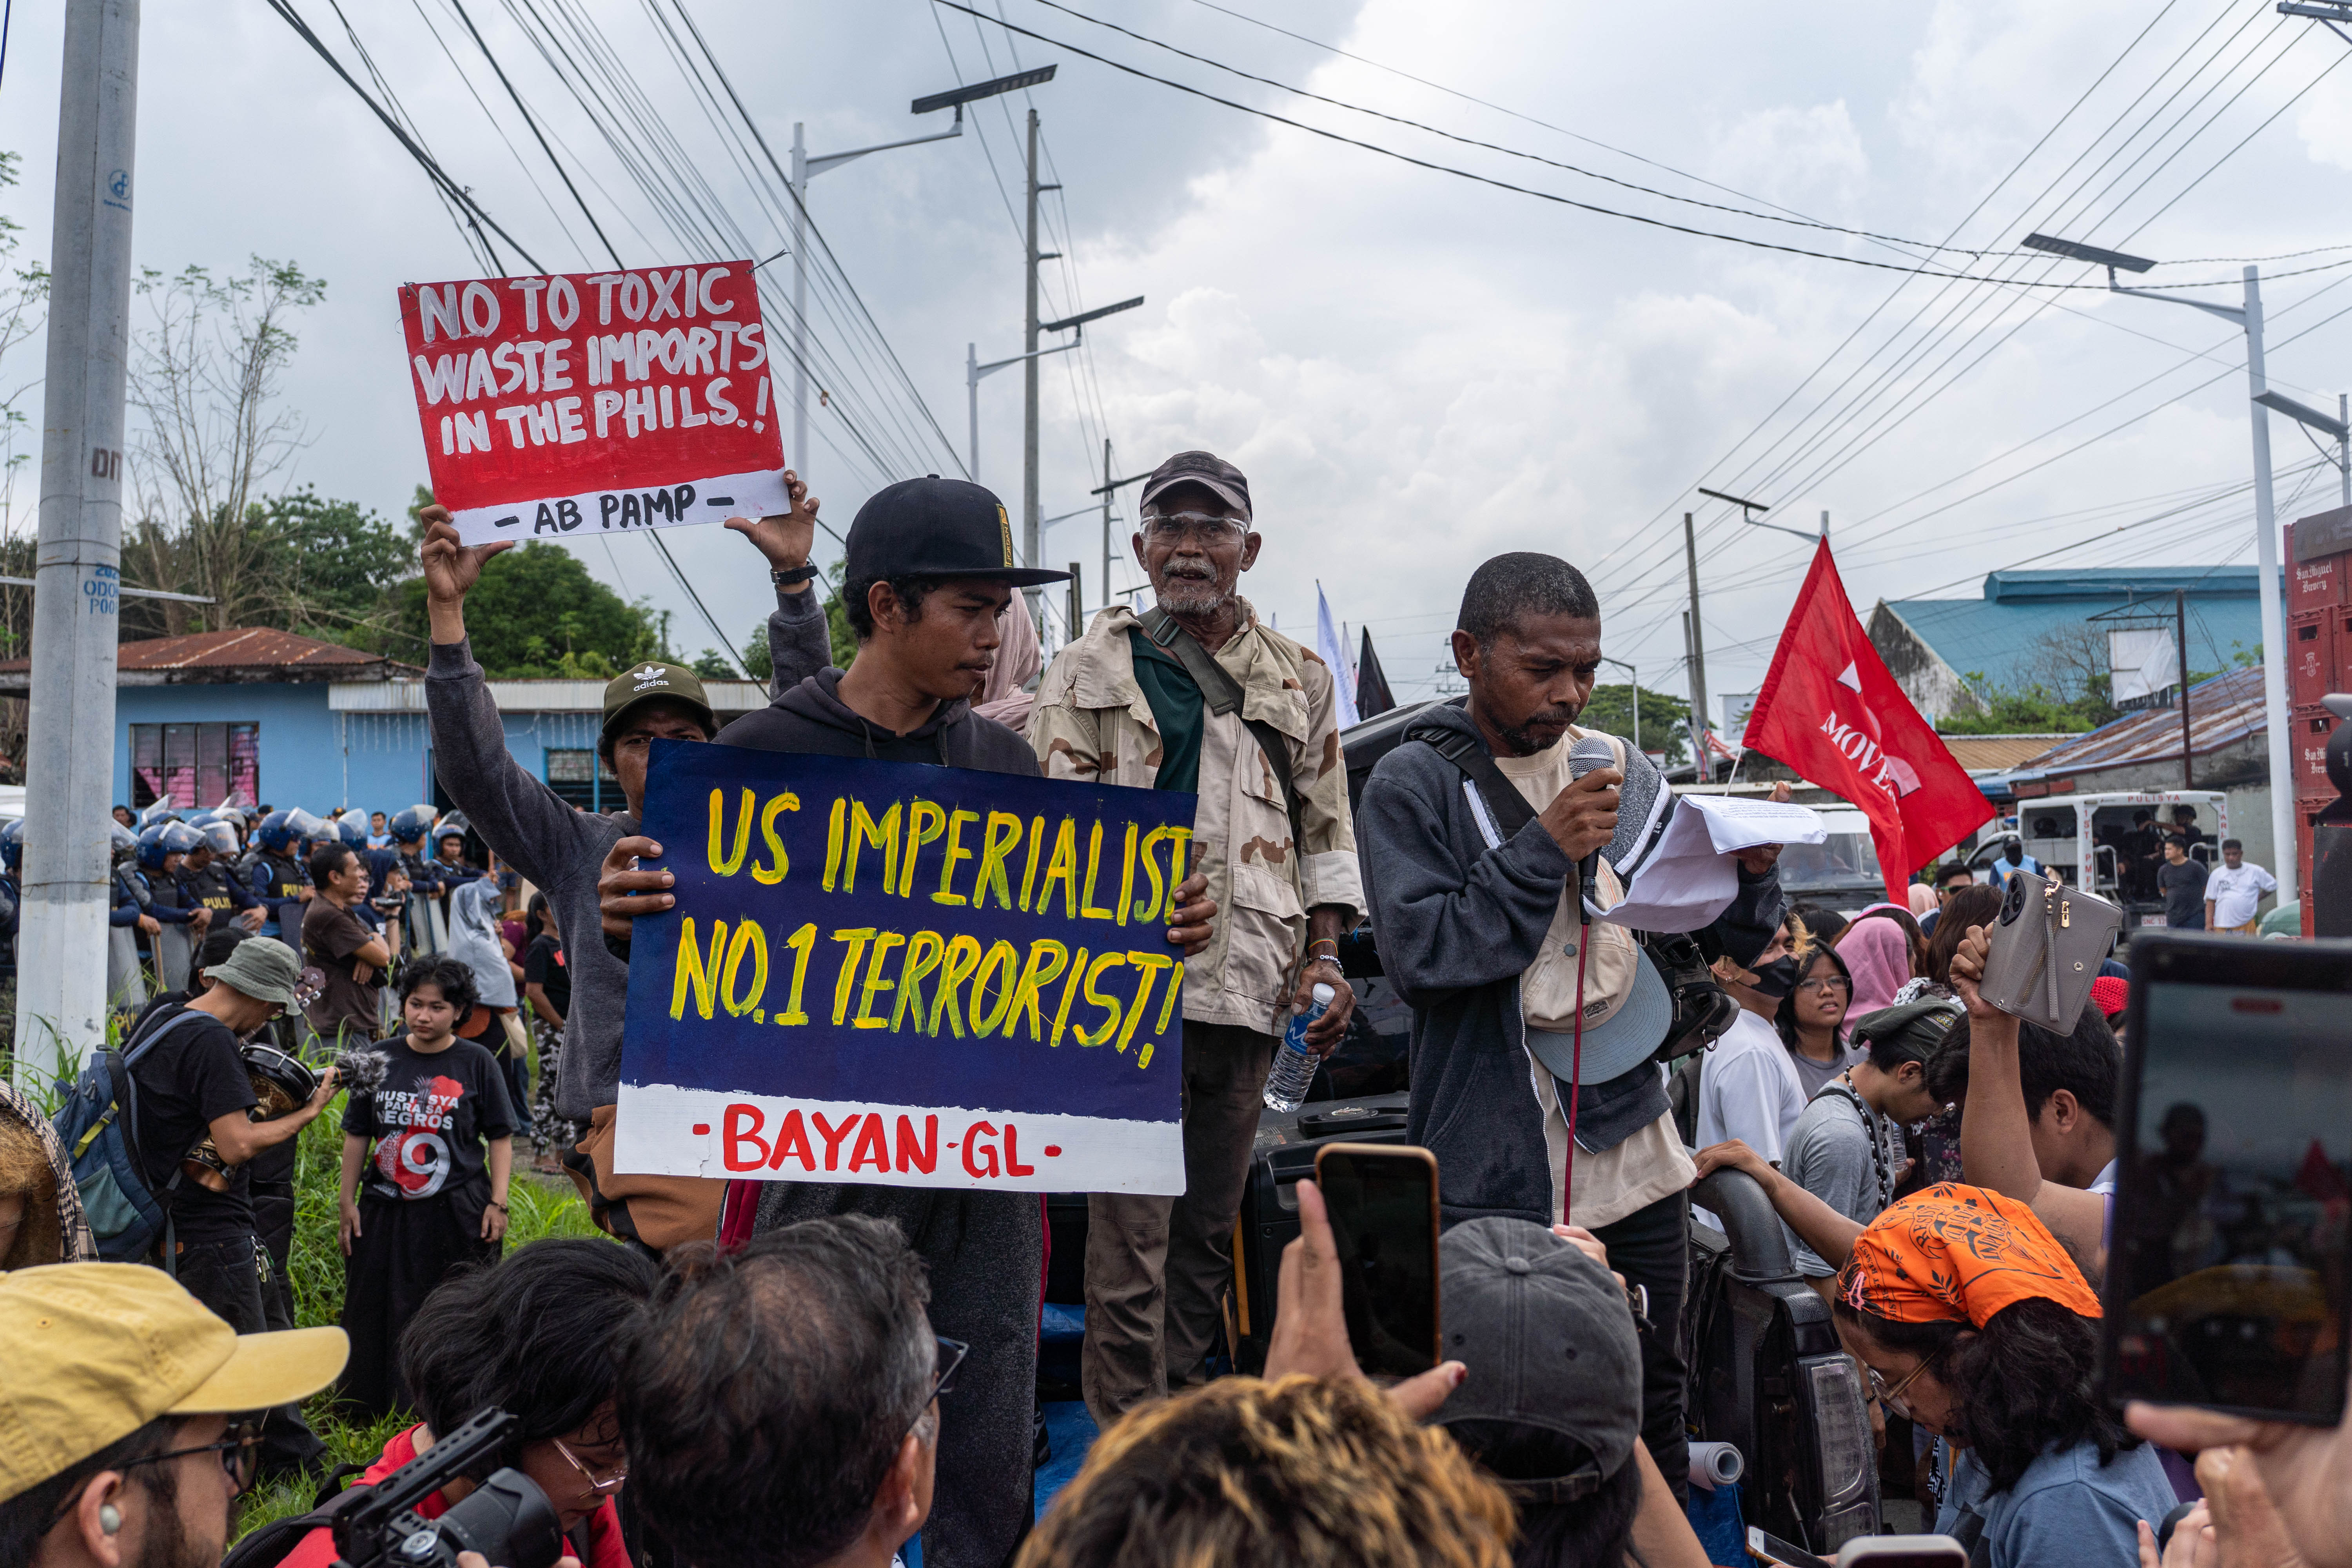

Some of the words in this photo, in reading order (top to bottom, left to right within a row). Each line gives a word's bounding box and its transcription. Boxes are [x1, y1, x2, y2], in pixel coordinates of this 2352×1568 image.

[419, 281, 501, 343] NO
[510, 275, 580, 332] TO
[586, 267, 735, 326] TOXIC
[414, 338, 573, 405] WASTE
[586, 320, 767, 387] IMPORTS
[441, 410, 492, 456] IN
[495, 396, 587, 449] THE
[534, 499, 583, 534] AB
[599, 483, 696, 529] PAMP
[2309, 560, 2332, 578] Miguel
[2303, 580, 2327, 593] Brewery
[633, 679, 669, 691] adidas
[2127, 794, 2180, 803] PULISYA
[708, 788, 801, 885] US
[822, 795, 1193, 927] IMPERIALIST
[830, 926, 1184, 1069] TERRORIST!
[1587, 1006, 1608, 1018] patagonia
[384, 1101, 421, 1113] PARA
[425, 1105, 443, 1115] SA
[377, 1110, 454, 1130] NEGROS
